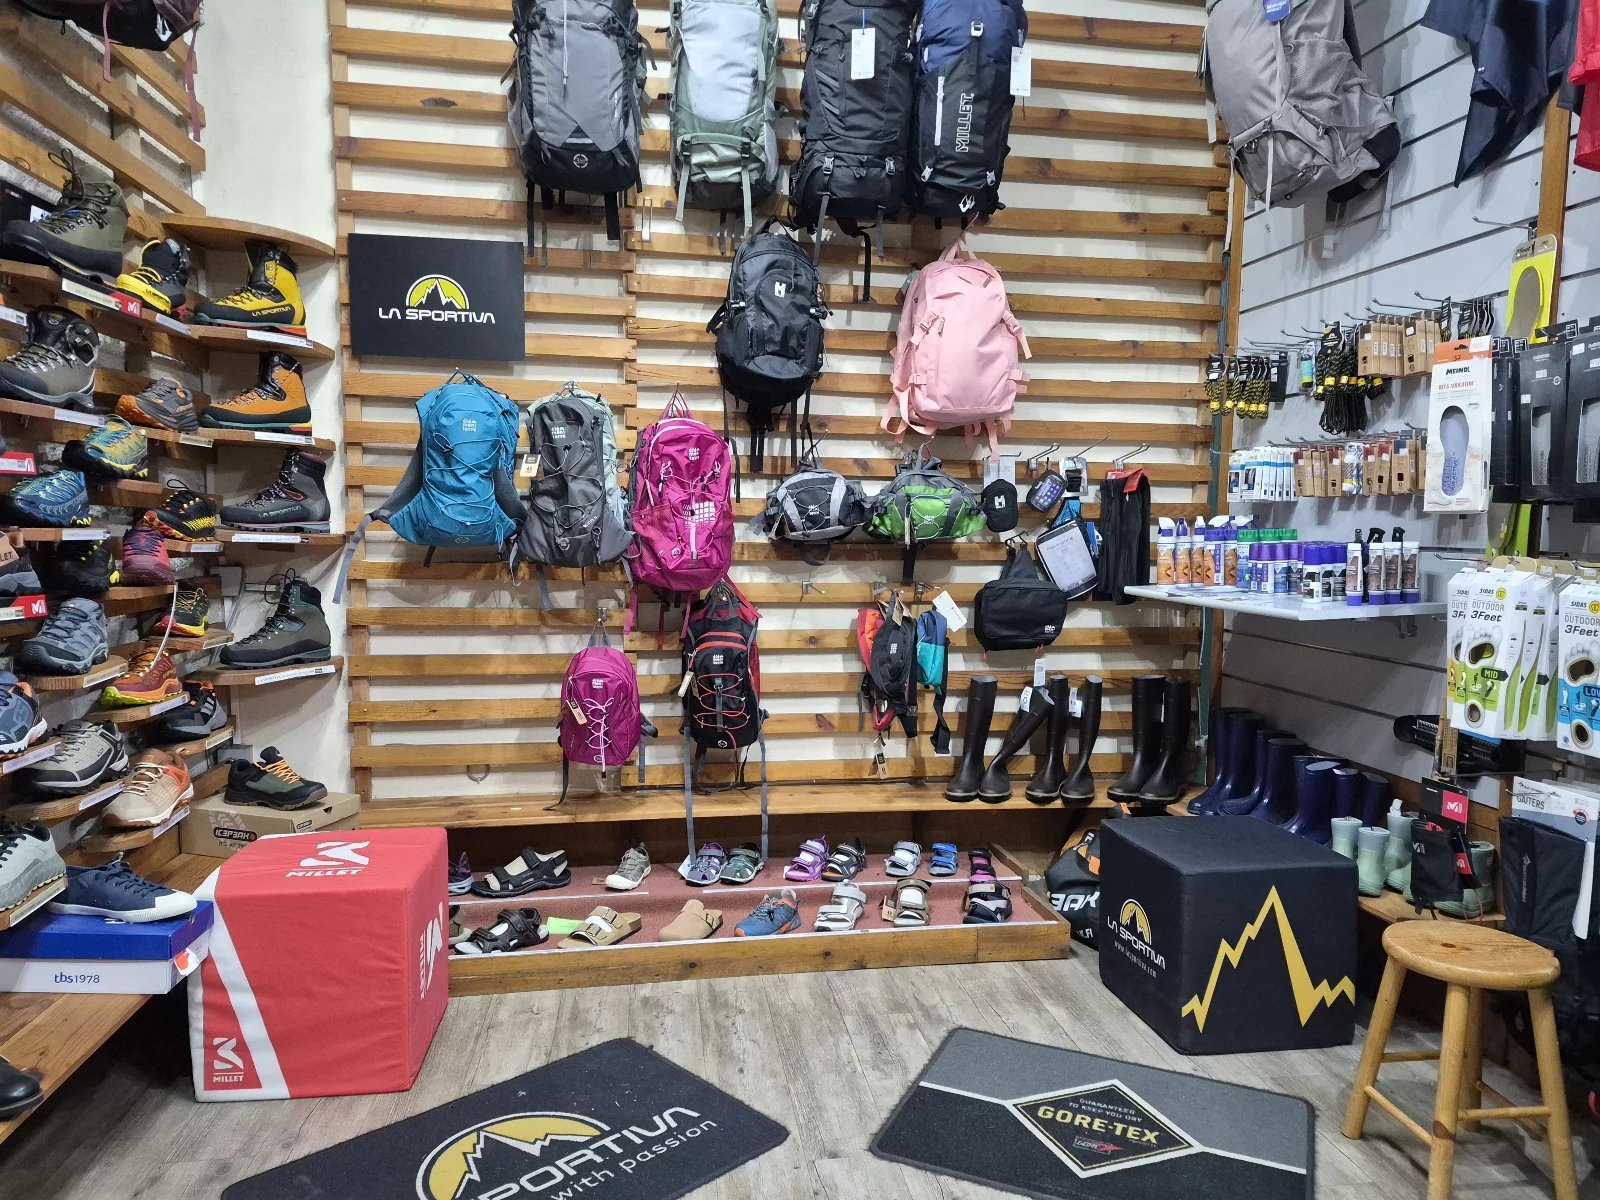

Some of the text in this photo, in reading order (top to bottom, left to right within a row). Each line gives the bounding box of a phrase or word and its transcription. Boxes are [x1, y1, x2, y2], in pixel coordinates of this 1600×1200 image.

[955, 93, 974, 153] MILLET
[261, 305, 291, 315] SPORTIVA
[378, 307, 495, 324] LA SPORTIVA
[1445, 366, 1471, 375] MEINDL
[269, 505, 302, 517] SPORTIVA
[1471, 600, 1505, 612] OUTDOOR
[1470, 610, 1502, 622] 3Feet
[1564, 624, 1599, 637] 3Feet
[1484, 669, 1498, 679] MID
[1516, 795, 1545, 810] GAITERS
[286, 869, 363, 878] MILLET
[1107, 915, 1166, 970] LA SPORTIVA
[212, 1075, 244, 1083] MILLET
[1079, 1098, 1136, 1115] GUARANTEED
[1081, 1105, 1104, 1113] KEEP
[1105, 1111, 1123, 1119] YOU
[1125, 1115, 1143, 1123] DRY
[1037, 1106, 1160, 1145] GORE-TEX
[470, 1106, 701, 1200] PORTIVA
[550, 1119, 717, 1200] with passion
